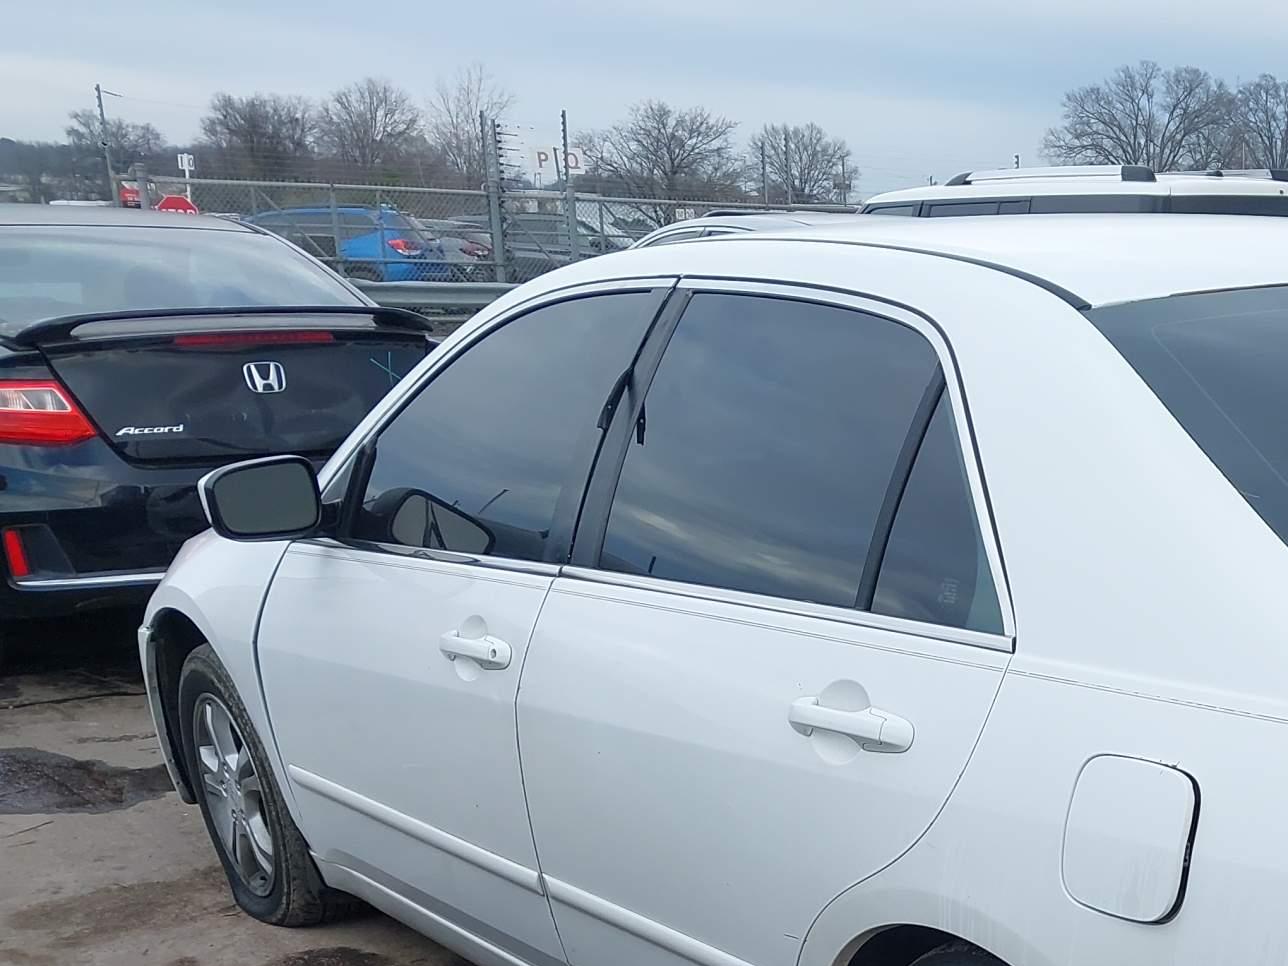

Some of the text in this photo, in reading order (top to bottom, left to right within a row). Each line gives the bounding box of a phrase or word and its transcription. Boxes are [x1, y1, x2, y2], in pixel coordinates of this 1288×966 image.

[537, 151, 549, 168] P
[566, 152, 581, 169] Q
[115, 424, 184, 436] Accord
